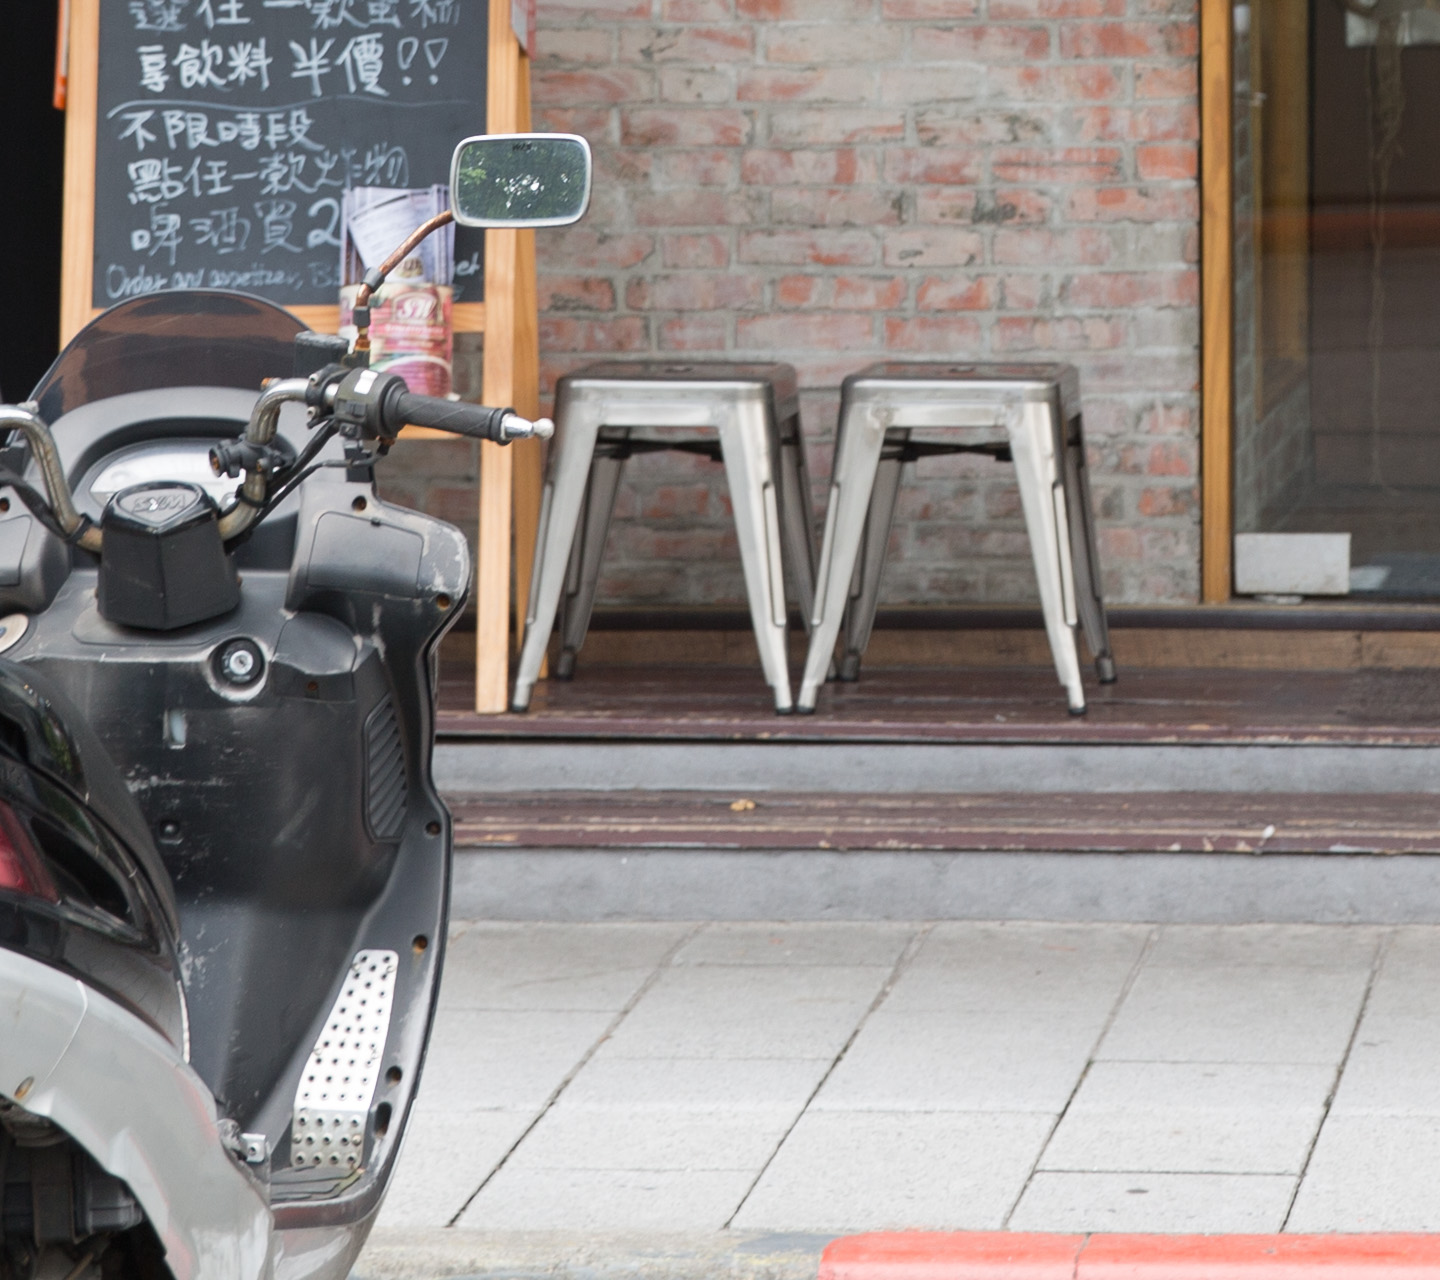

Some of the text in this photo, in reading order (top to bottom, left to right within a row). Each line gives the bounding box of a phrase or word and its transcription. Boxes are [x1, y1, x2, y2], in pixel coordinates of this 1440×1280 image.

[119, 109, 327, 152] 不限時段
[127, 143, 410, 203] 點任一款炸物
